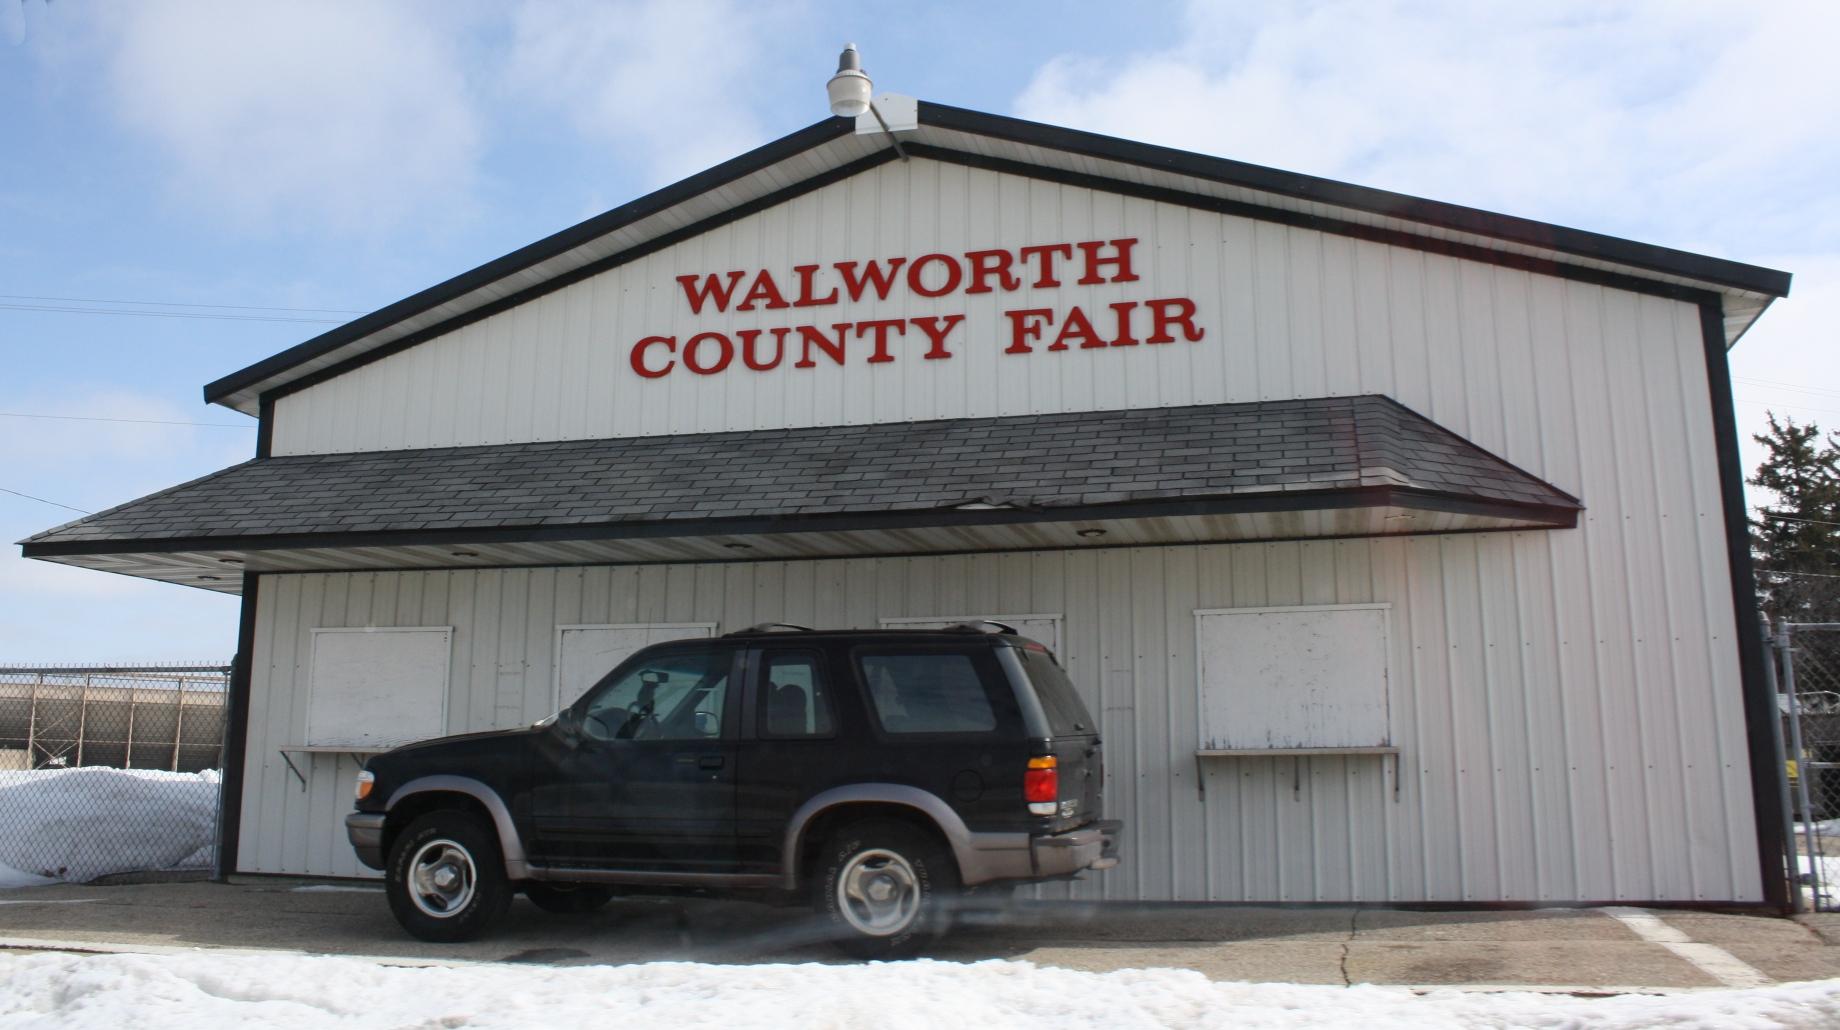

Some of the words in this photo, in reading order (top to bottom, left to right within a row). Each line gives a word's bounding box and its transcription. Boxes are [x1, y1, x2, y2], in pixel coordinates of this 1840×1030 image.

[676, 237, 1139, 314] WALWORTH
[630, 314, 965, 379] COUNTY
[1004, 297, 1205, 355] FAIR
